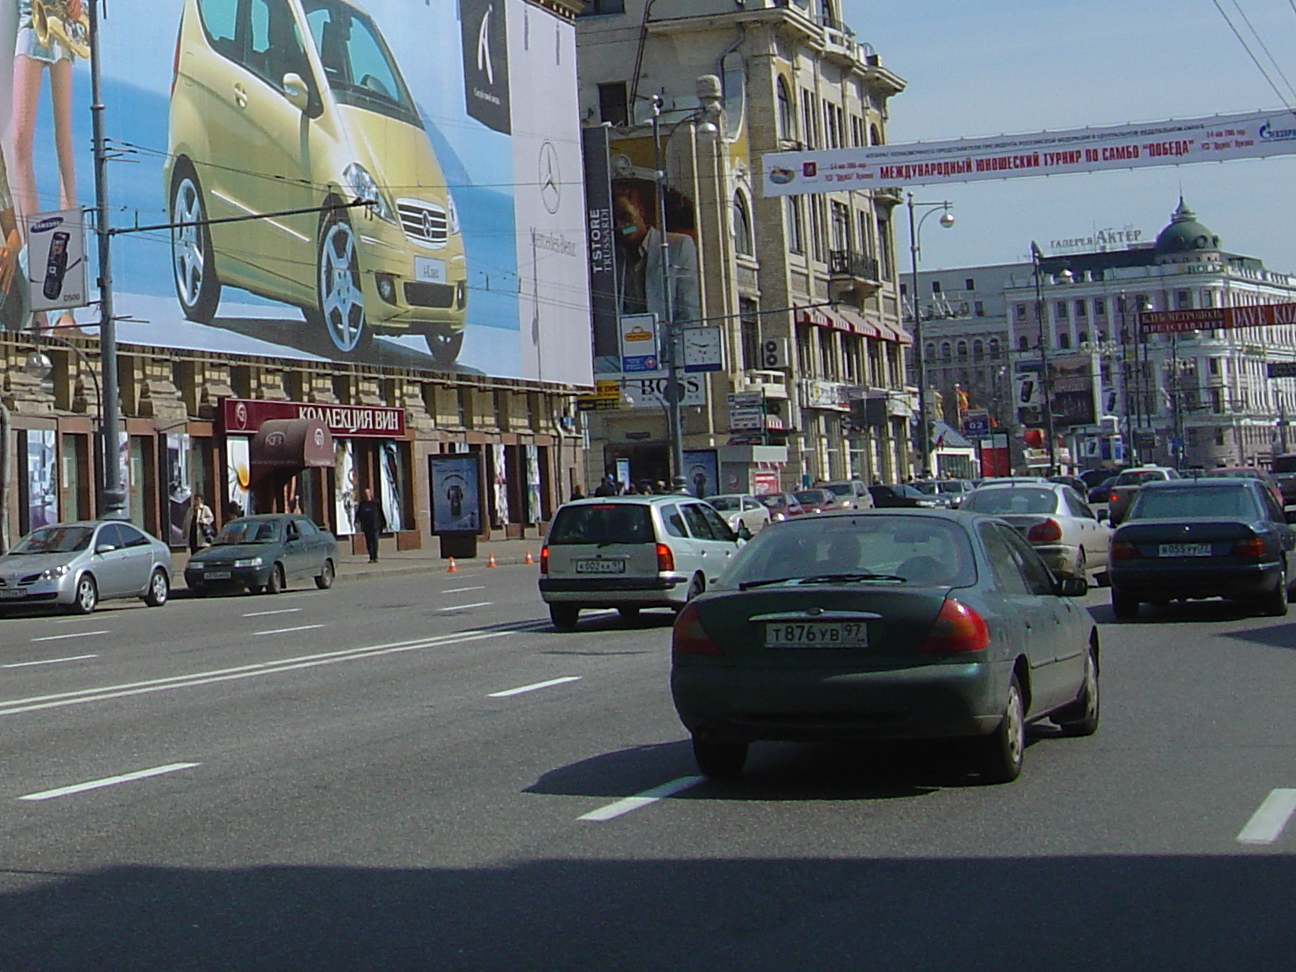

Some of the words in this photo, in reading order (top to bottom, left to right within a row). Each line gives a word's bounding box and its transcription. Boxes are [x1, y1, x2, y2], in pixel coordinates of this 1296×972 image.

[879, 157, 973, 180] МЕЖДУНАРОДНЫЙ
[976, 151, 1040, 172] ЮНОШЕСКИЙ
[1043, 149, 1081, 167] ТУРНИР
[1085, 148, 1099, 163] ПО
[1102, 144, 1140, 161] САМБО
[601, 208, 613, 273] TRUSSARDI
[1232, 305, 1266, 327] DAVE
[375, 410, 399, 431] ВИН
[845, 624, 861, 637] 97
